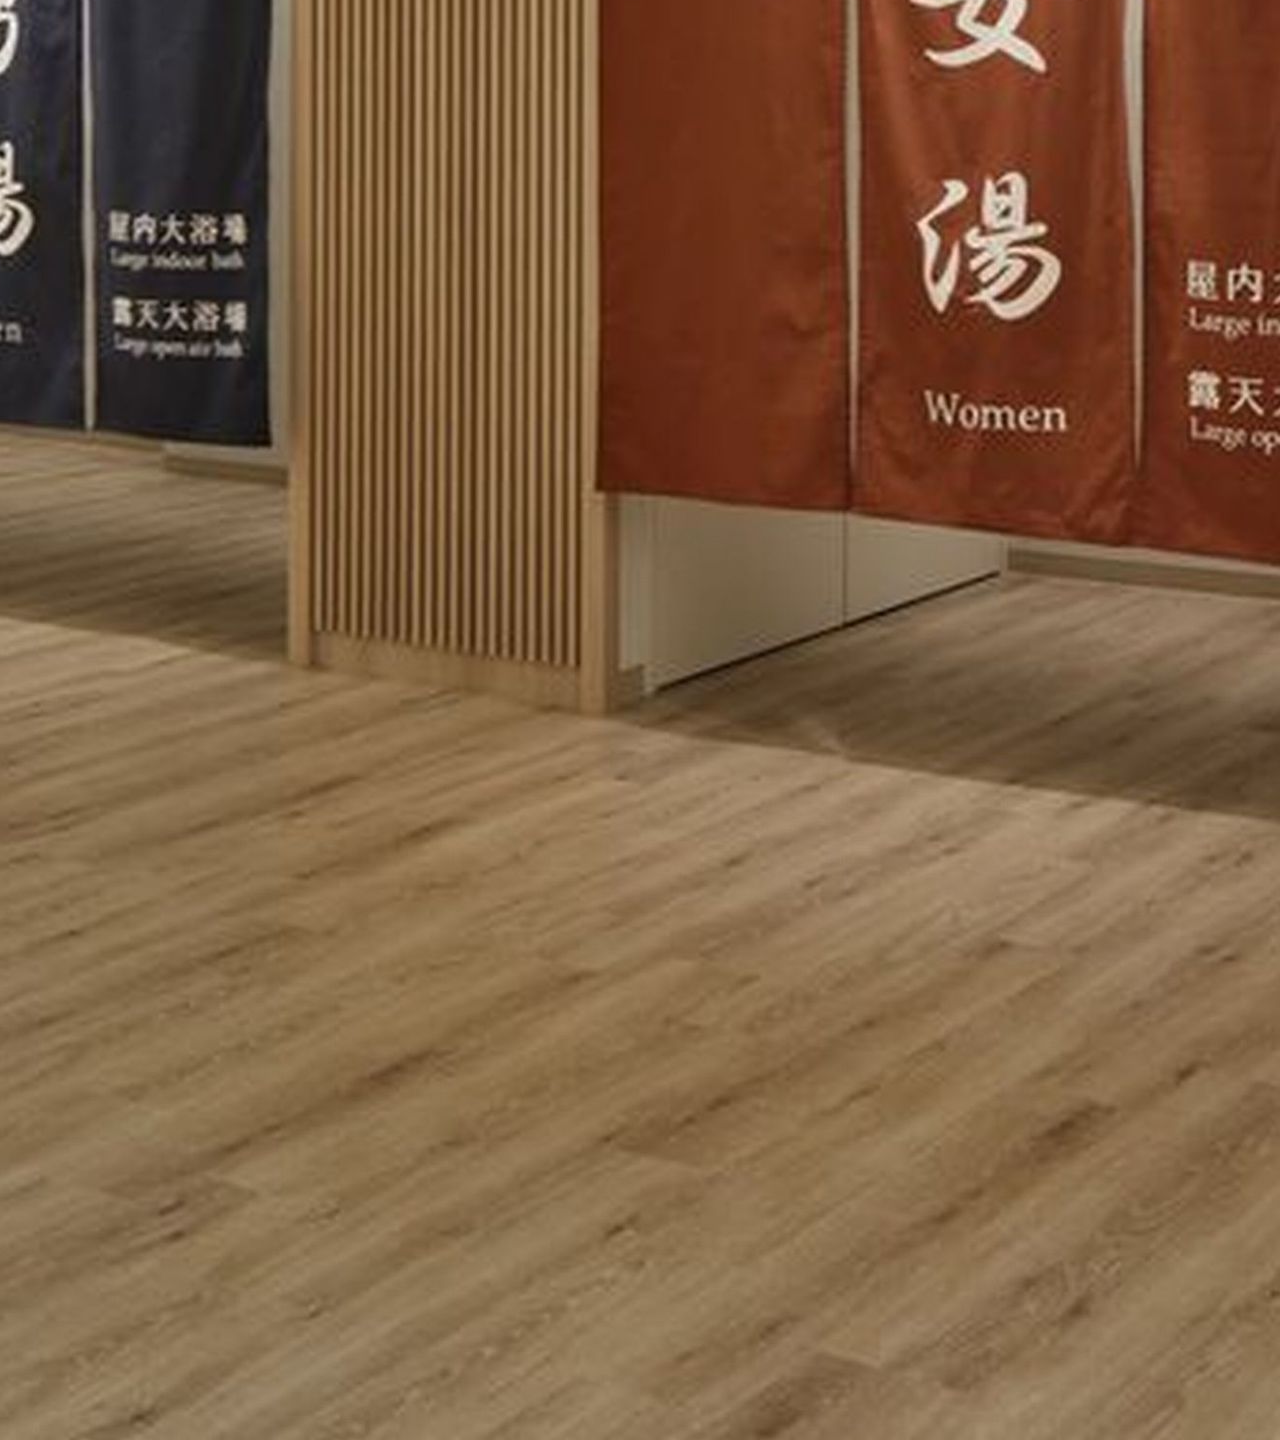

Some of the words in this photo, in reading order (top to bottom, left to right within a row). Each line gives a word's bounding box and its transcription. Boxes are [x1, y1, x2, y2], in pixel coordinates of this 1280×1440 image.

[1189, 307, 1251, 340] Large
[924, 389, 1067, 433] Women
[1190, 415, 1247, 451] Large
